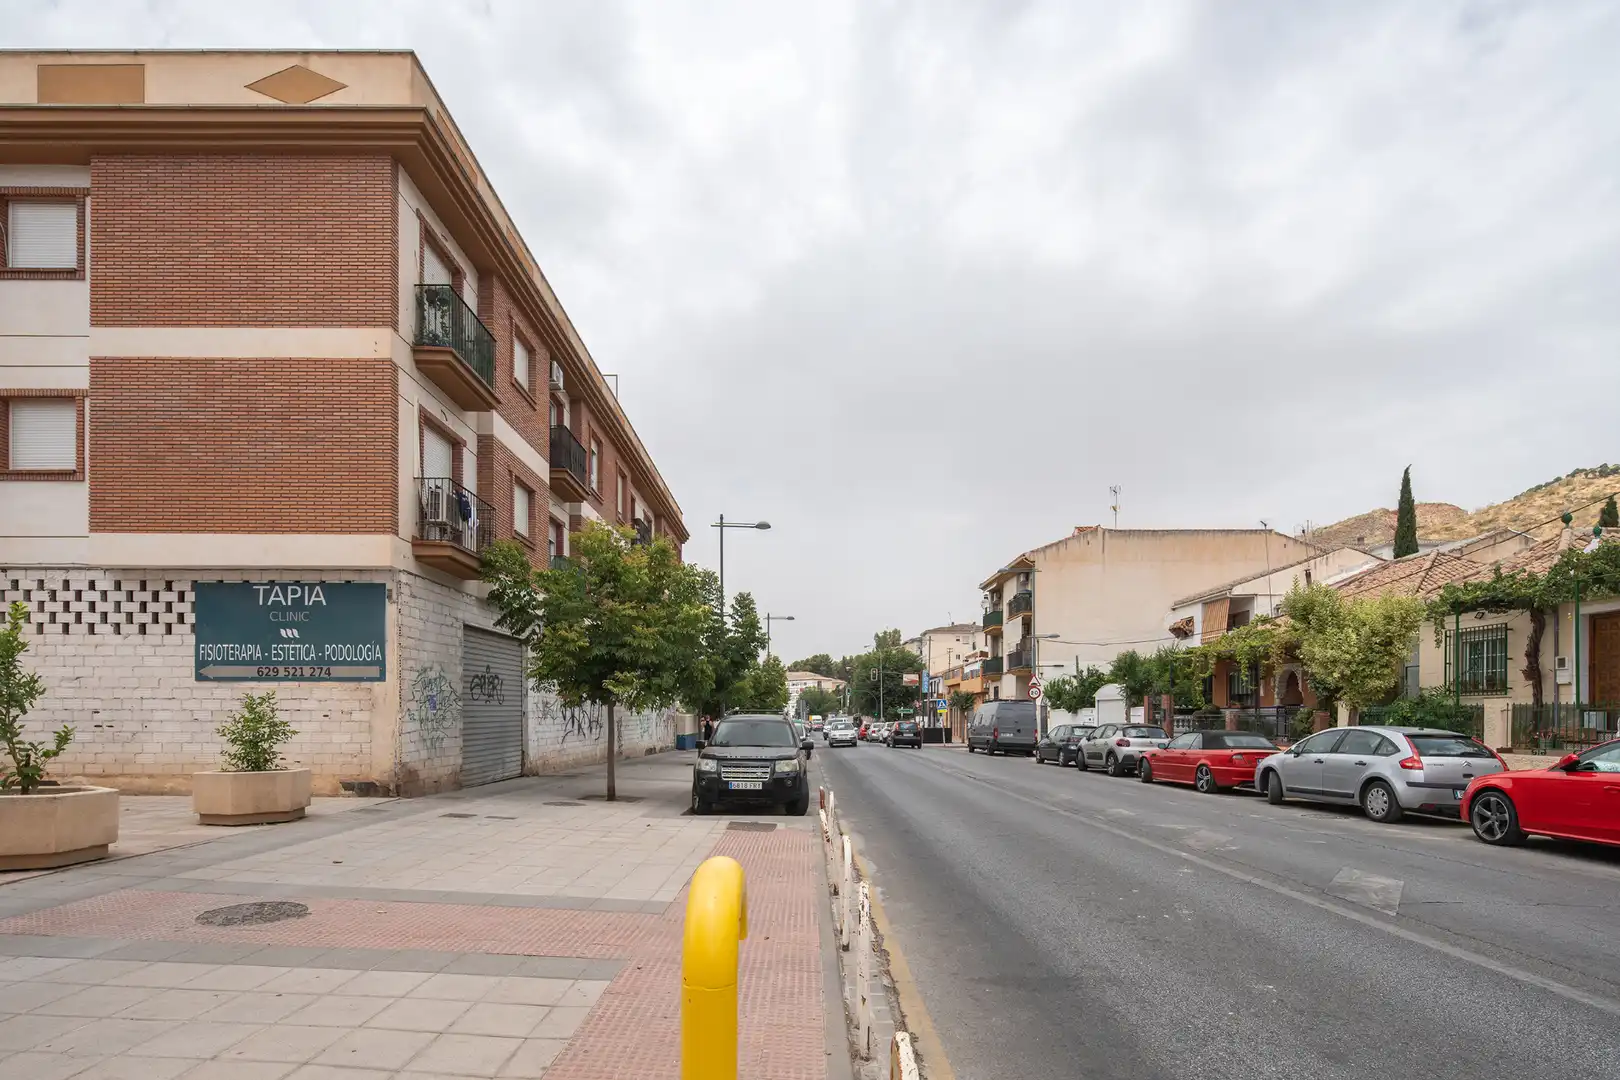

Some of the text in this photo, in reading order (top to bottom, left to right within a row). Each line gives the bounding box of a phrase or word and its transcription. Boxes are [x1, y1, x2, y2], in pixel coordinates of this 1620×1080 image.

[253, 585, 326, 606] TAPIA
[269, 611, 310, 622] CLINIC
[199, 643, 262, 661] FISIOTERAPIA
[271, 640, 316, 661] ESTÉTICA
[325, 640, 382, 661] PODOLOGÍA
[257, 666, 332, 677] 629 521 274
